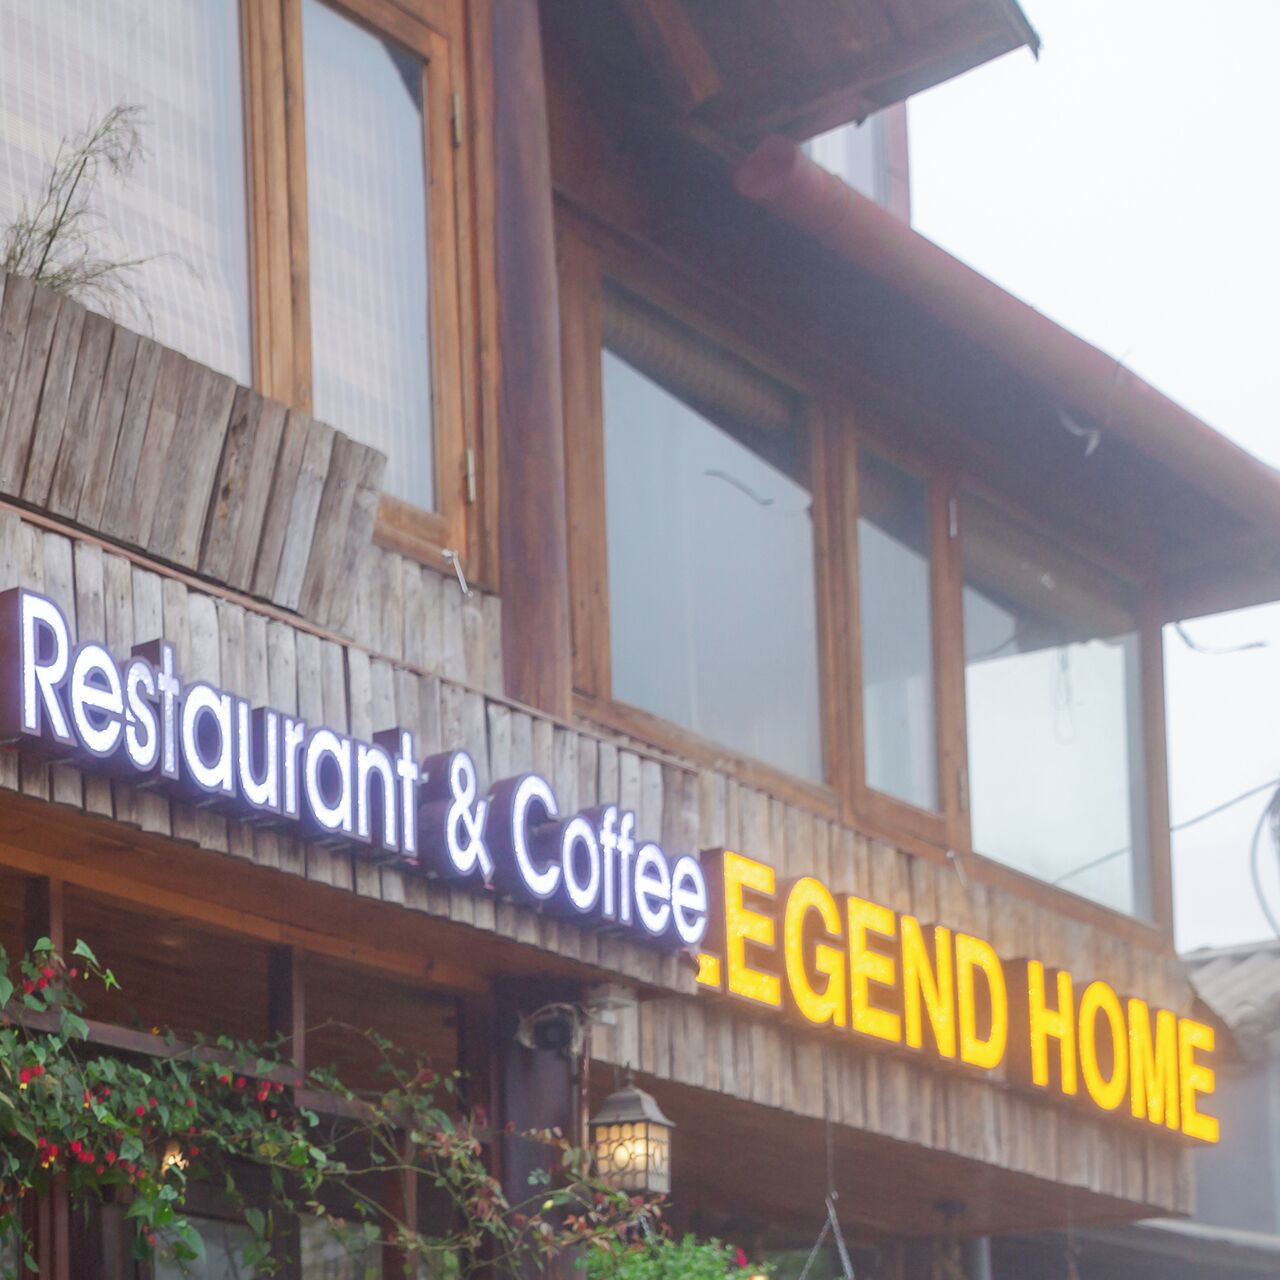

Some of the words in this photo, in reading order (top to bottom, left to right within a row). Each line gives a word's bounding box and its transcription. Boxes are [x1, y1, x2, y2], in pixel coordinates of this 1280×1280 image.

[20, 593, 420, 858] Restaurant
[446, 750, 494, 883] &
[510, 774, 708, 946] Coffee
[696, 850, 1008, 1070] EGEND
[1028, 958, 1220, 1144] HOME
